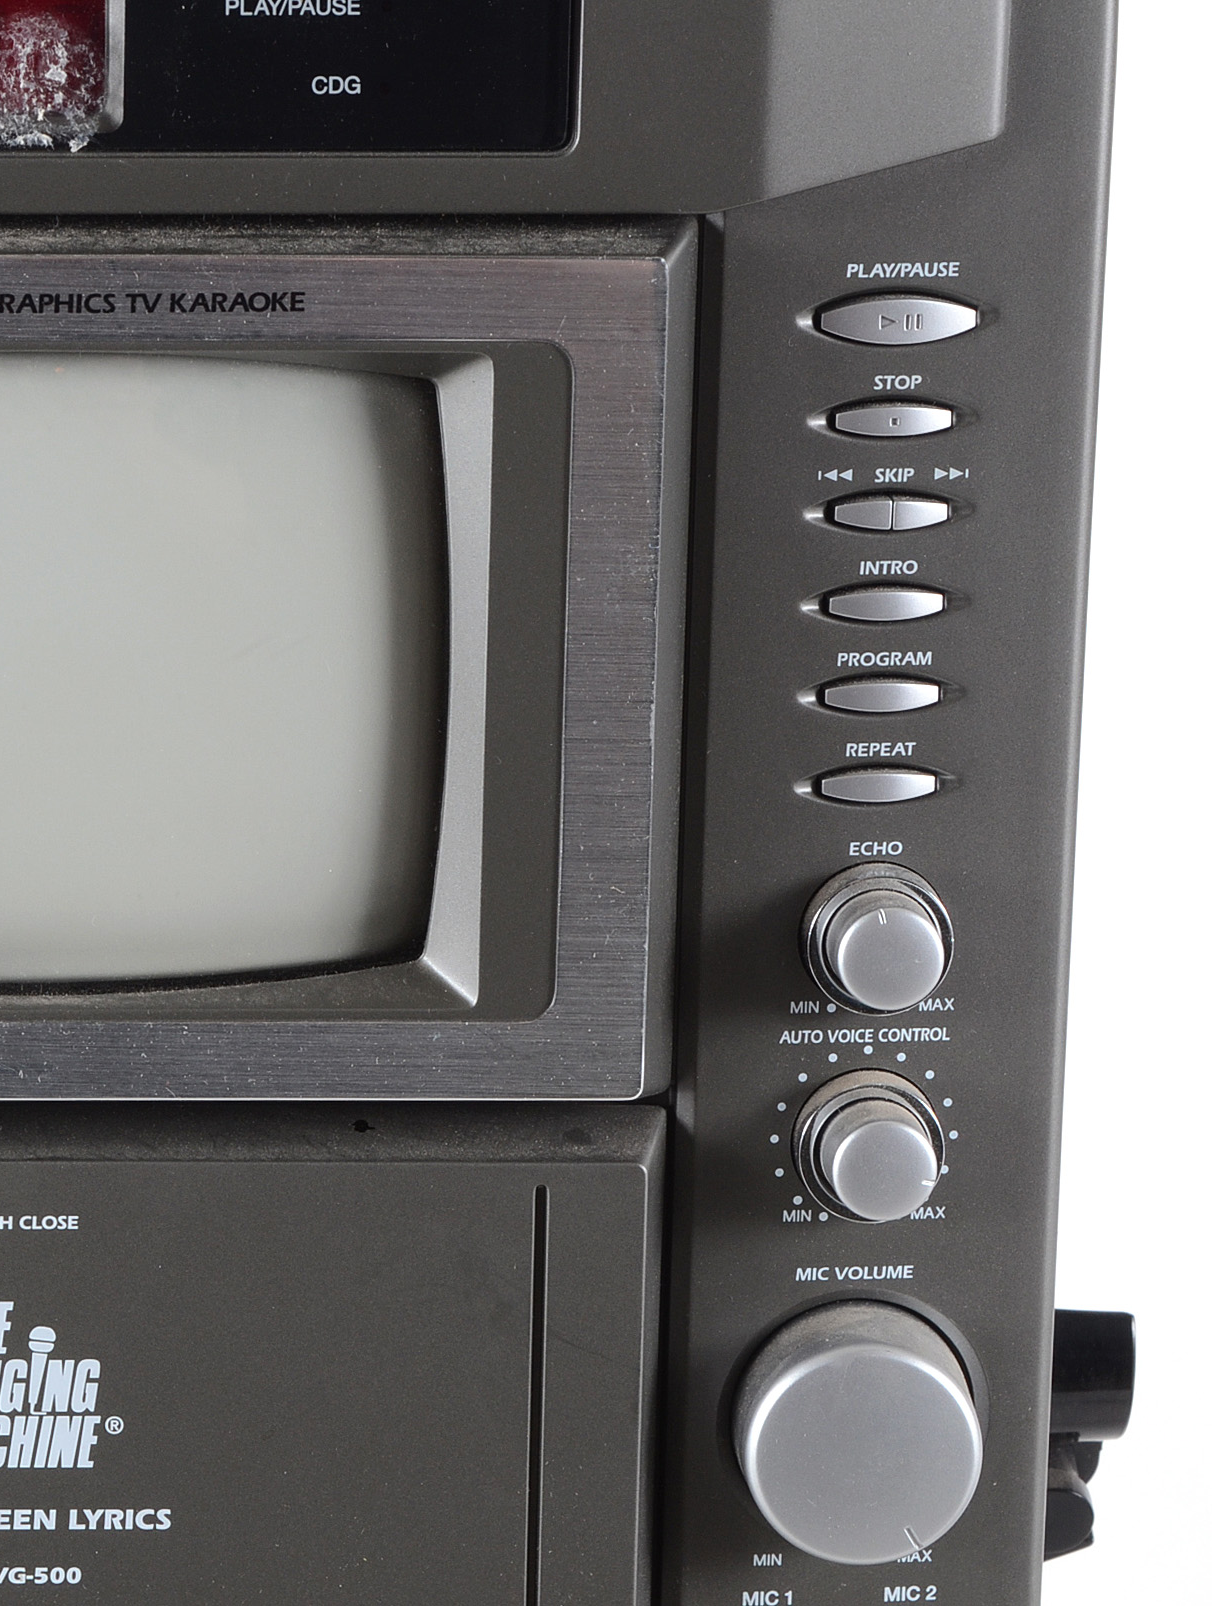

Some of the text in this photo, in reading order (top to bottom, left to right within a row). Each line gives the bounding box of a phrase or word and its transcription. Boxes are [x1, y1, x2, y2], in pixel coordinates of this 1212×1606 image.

[225, 0, 361, 16] PLAY/PAUSE
[311, 75, 362, 95] CDG
[846, 261, 960, 278] PLAY/PAUSE
[124, 292, 162, 313] TV
[169, 291, 306, 313] KARAOKE
[873, 375, 922, 391] STOP
[874, 467, 915, 483] SKIP
[859, 560, 918, 576] INTRO
[837, 651, 933, 668] PROGRAM
[845, 741, 916, 758] REPEAT
[849, 841, 903, 856] ECHO
[790, 1000, 819, 1015] MIN
[918, 997, 955, 1012] MAX
[779, 1027, 950, 1045] AUTO VOICE CONTROL
[782, 1209, 812, 1224] MIN
[909, 1205, 946, 1220] MAX
[20, 1215, 79, 1230] CLOSE
[795, 1265, 914, 1282] MIC VOLUME
[68, 1509, 172, 1531] LYRICS
[753, 1554, 782, 1568] MIN
[742, 1590, 793, 1606] MIC 1
[883, 1585, 937, 1602] MIC 2
